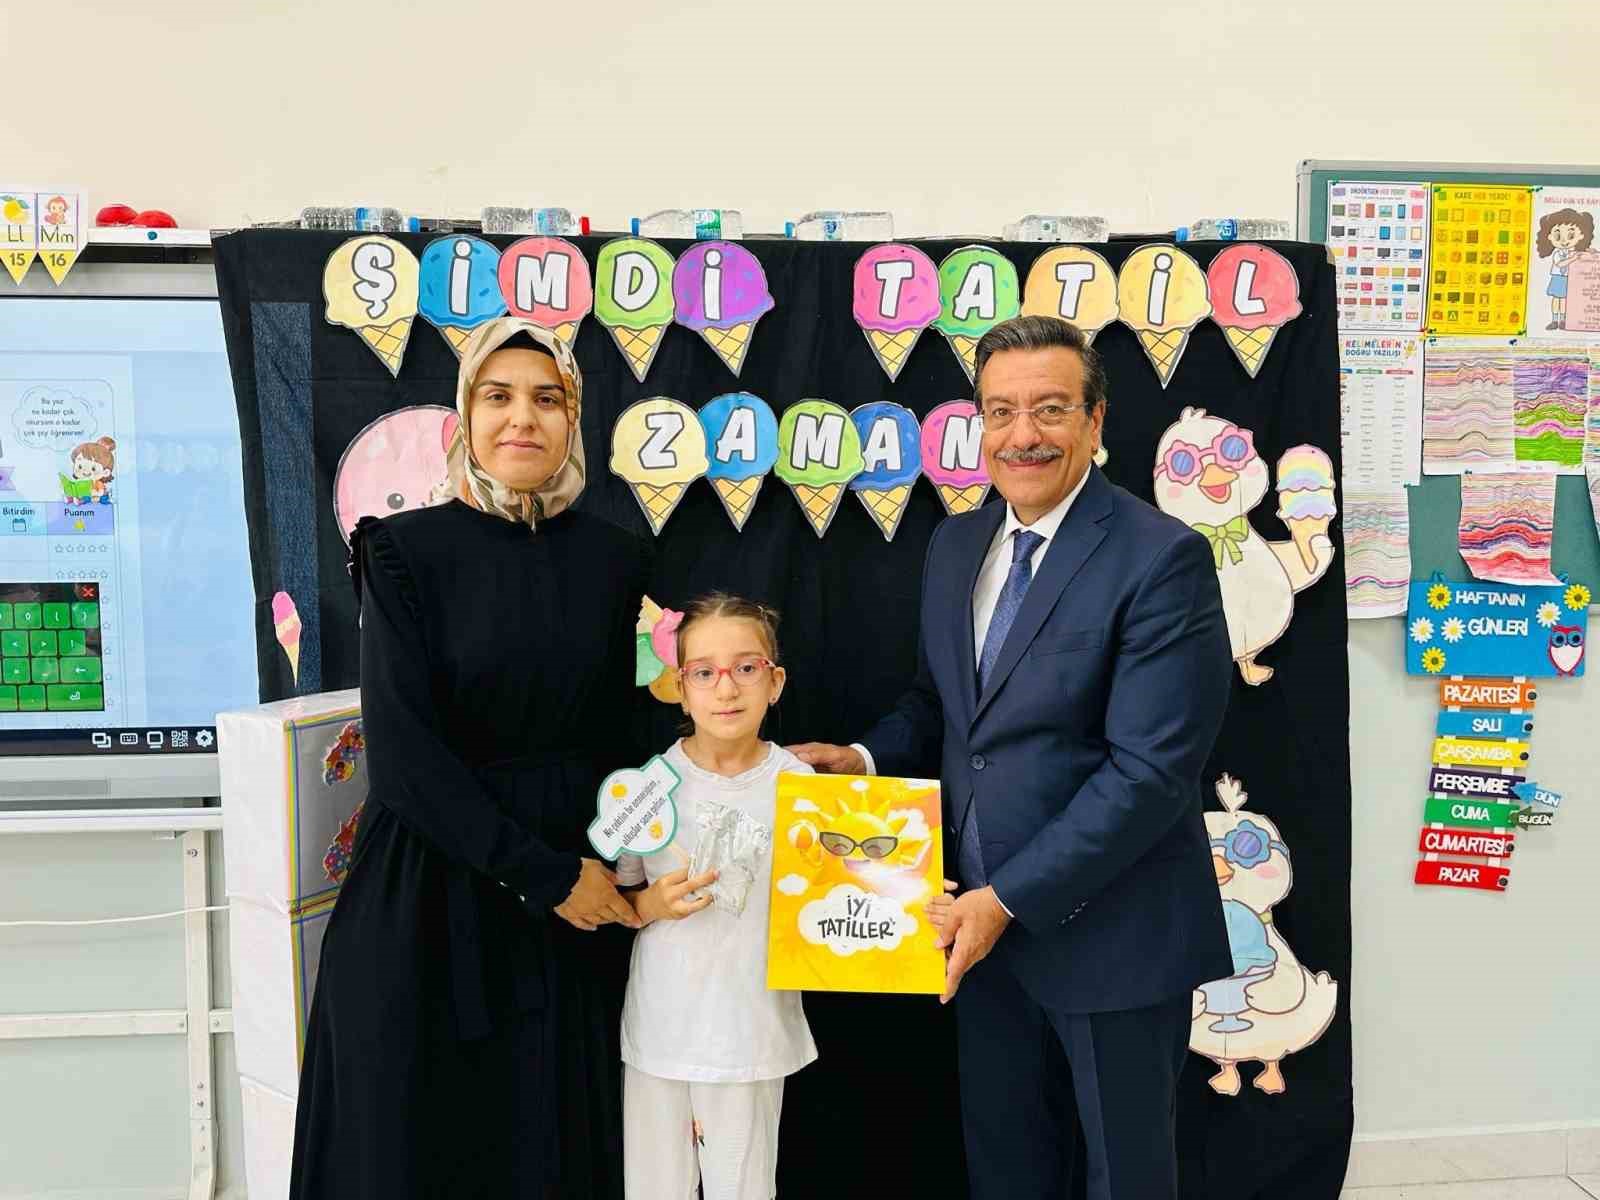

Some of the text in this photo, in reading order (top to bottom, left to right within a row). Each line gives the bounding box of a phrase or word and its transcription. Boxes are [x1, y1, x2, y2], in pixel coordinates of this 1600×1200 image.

[40, 224, 75, 243] Mm
[9, 253, 26, 267] 15
[49, 253, 67, 267] 16
[352, 239, 1266, 328] ŞİMDİ TATİL
[637, 406, 984, 472] ZAMAN
[2, 508, 35, 517] Bitirdim
[64, 508, 95, 518] Puanım
[1455, 590, 1526, 607] HAFTANIN
[1467, 617, 1529, 637] GÜNLERİ
[1443, 684, 1521, 704] PAZARTESİ
[1471, 718, 1502, 733] SALI
[1438, 742, 1514, 762] ÇARŞAMBA
[1433, 773, 1511, 795] PERŞEMBE
[1534, 790, 1561, 808] DÜN
[1451, 804, 1491, 821] CUMA
[1518, 812, 1553, 826] BUGÜN
[1425, 832, 1506, 855] CUMARTESİ
[1438, 866, 1480, 883] PAZAR
